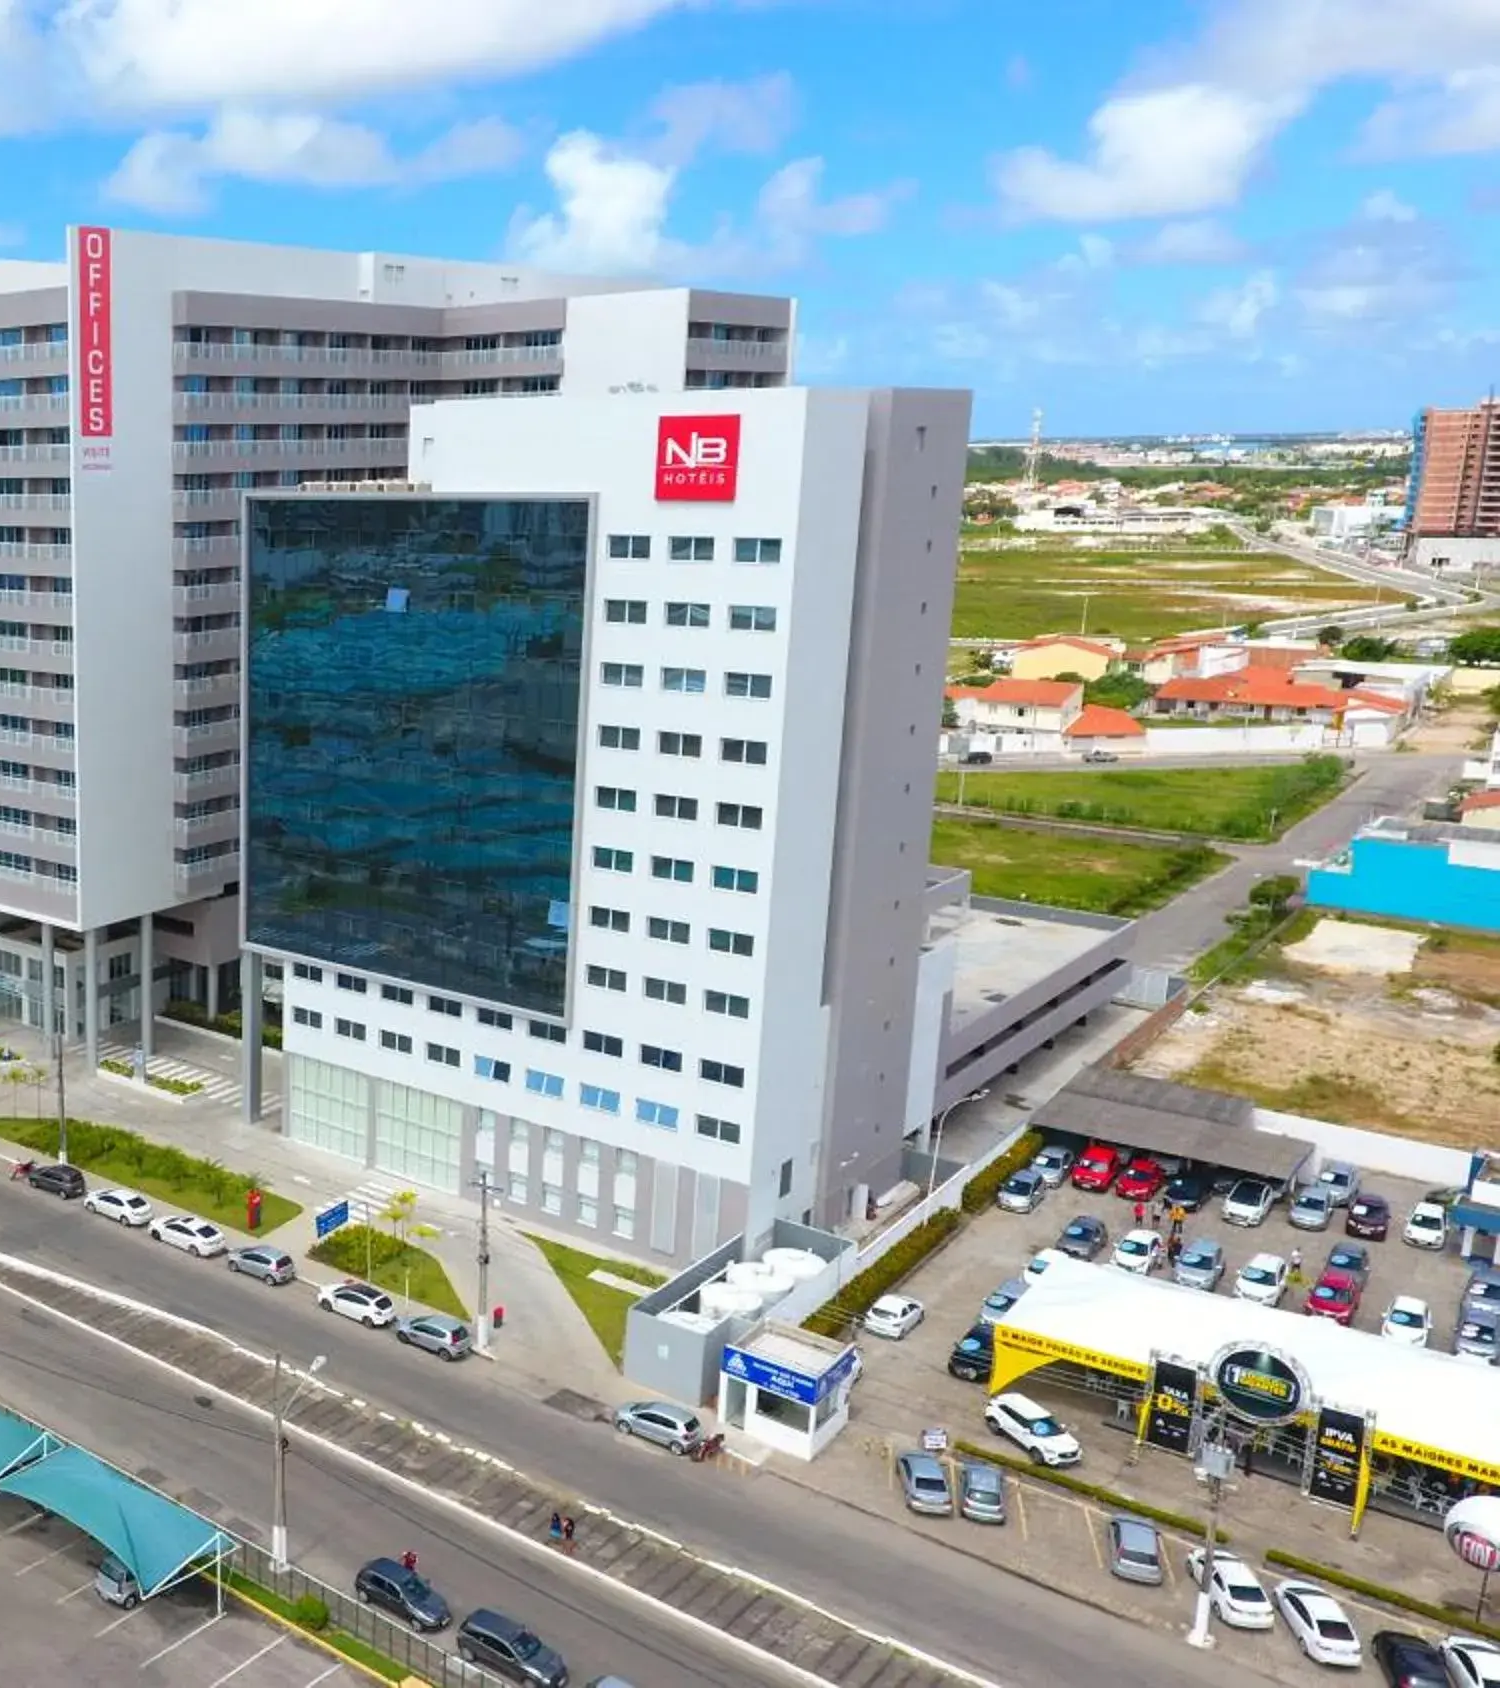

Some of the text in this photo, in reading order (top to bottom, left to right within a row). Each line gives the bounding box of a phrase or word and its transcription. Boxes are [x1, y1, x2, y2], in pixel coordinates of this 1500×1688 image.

[85, 233, 105, 431] OFFICES
[665, 431, 728, 468] NB
[1011, 1331, 1043, 1347] MAIOR
[1085, 1352, 1098, 1363] DE
[1100, 1357, 1144, 1375] SERGIPE
[1324, 1427, 1354, 1443] IPVA
[1401, 1444, 1463, 1468] MAIORES
[1461, 1535, 1497, 1568] FIAT
